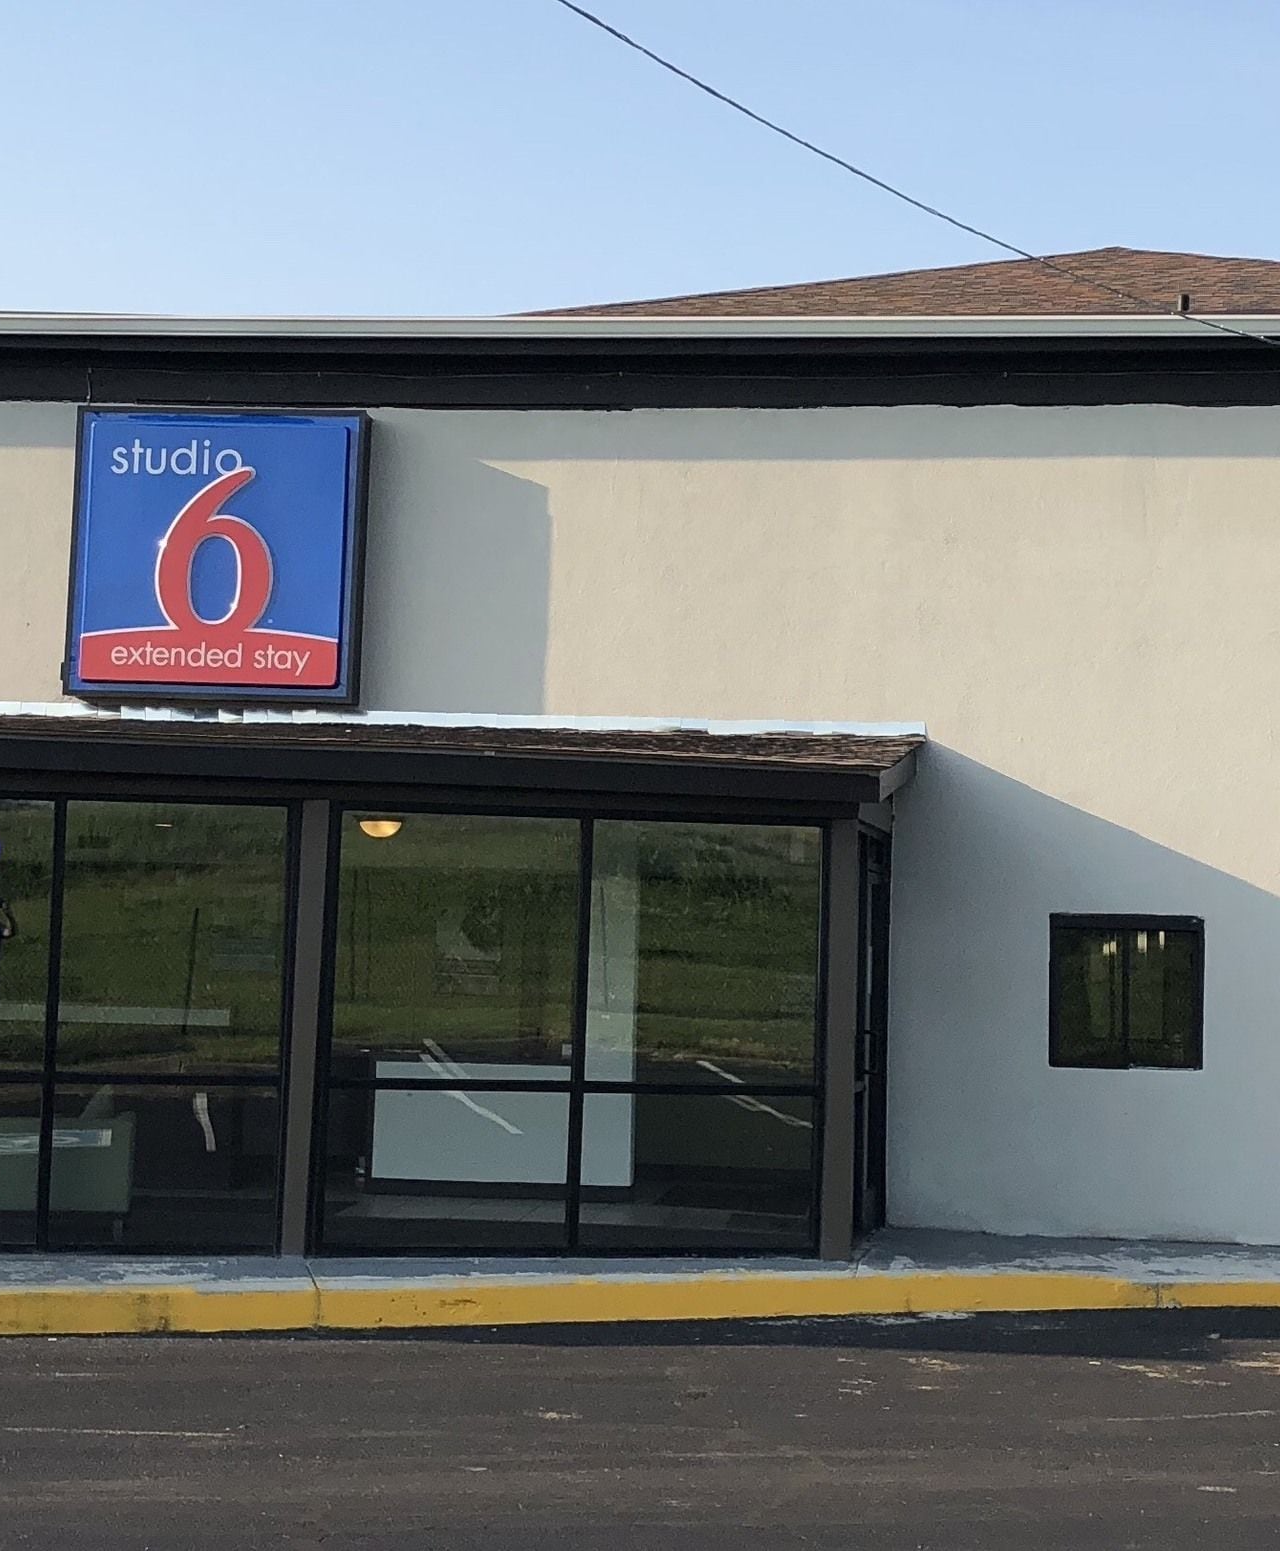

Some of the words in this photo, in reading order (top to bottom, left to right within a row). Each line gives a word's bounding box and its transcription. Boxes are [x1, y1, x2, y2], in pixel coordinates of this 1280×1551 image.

[110, 438, 242, 475] studio
[154, 466, 273, 630] 6
[111, 641, 242, 668] extended
[253, 644, 310, 676] stay
